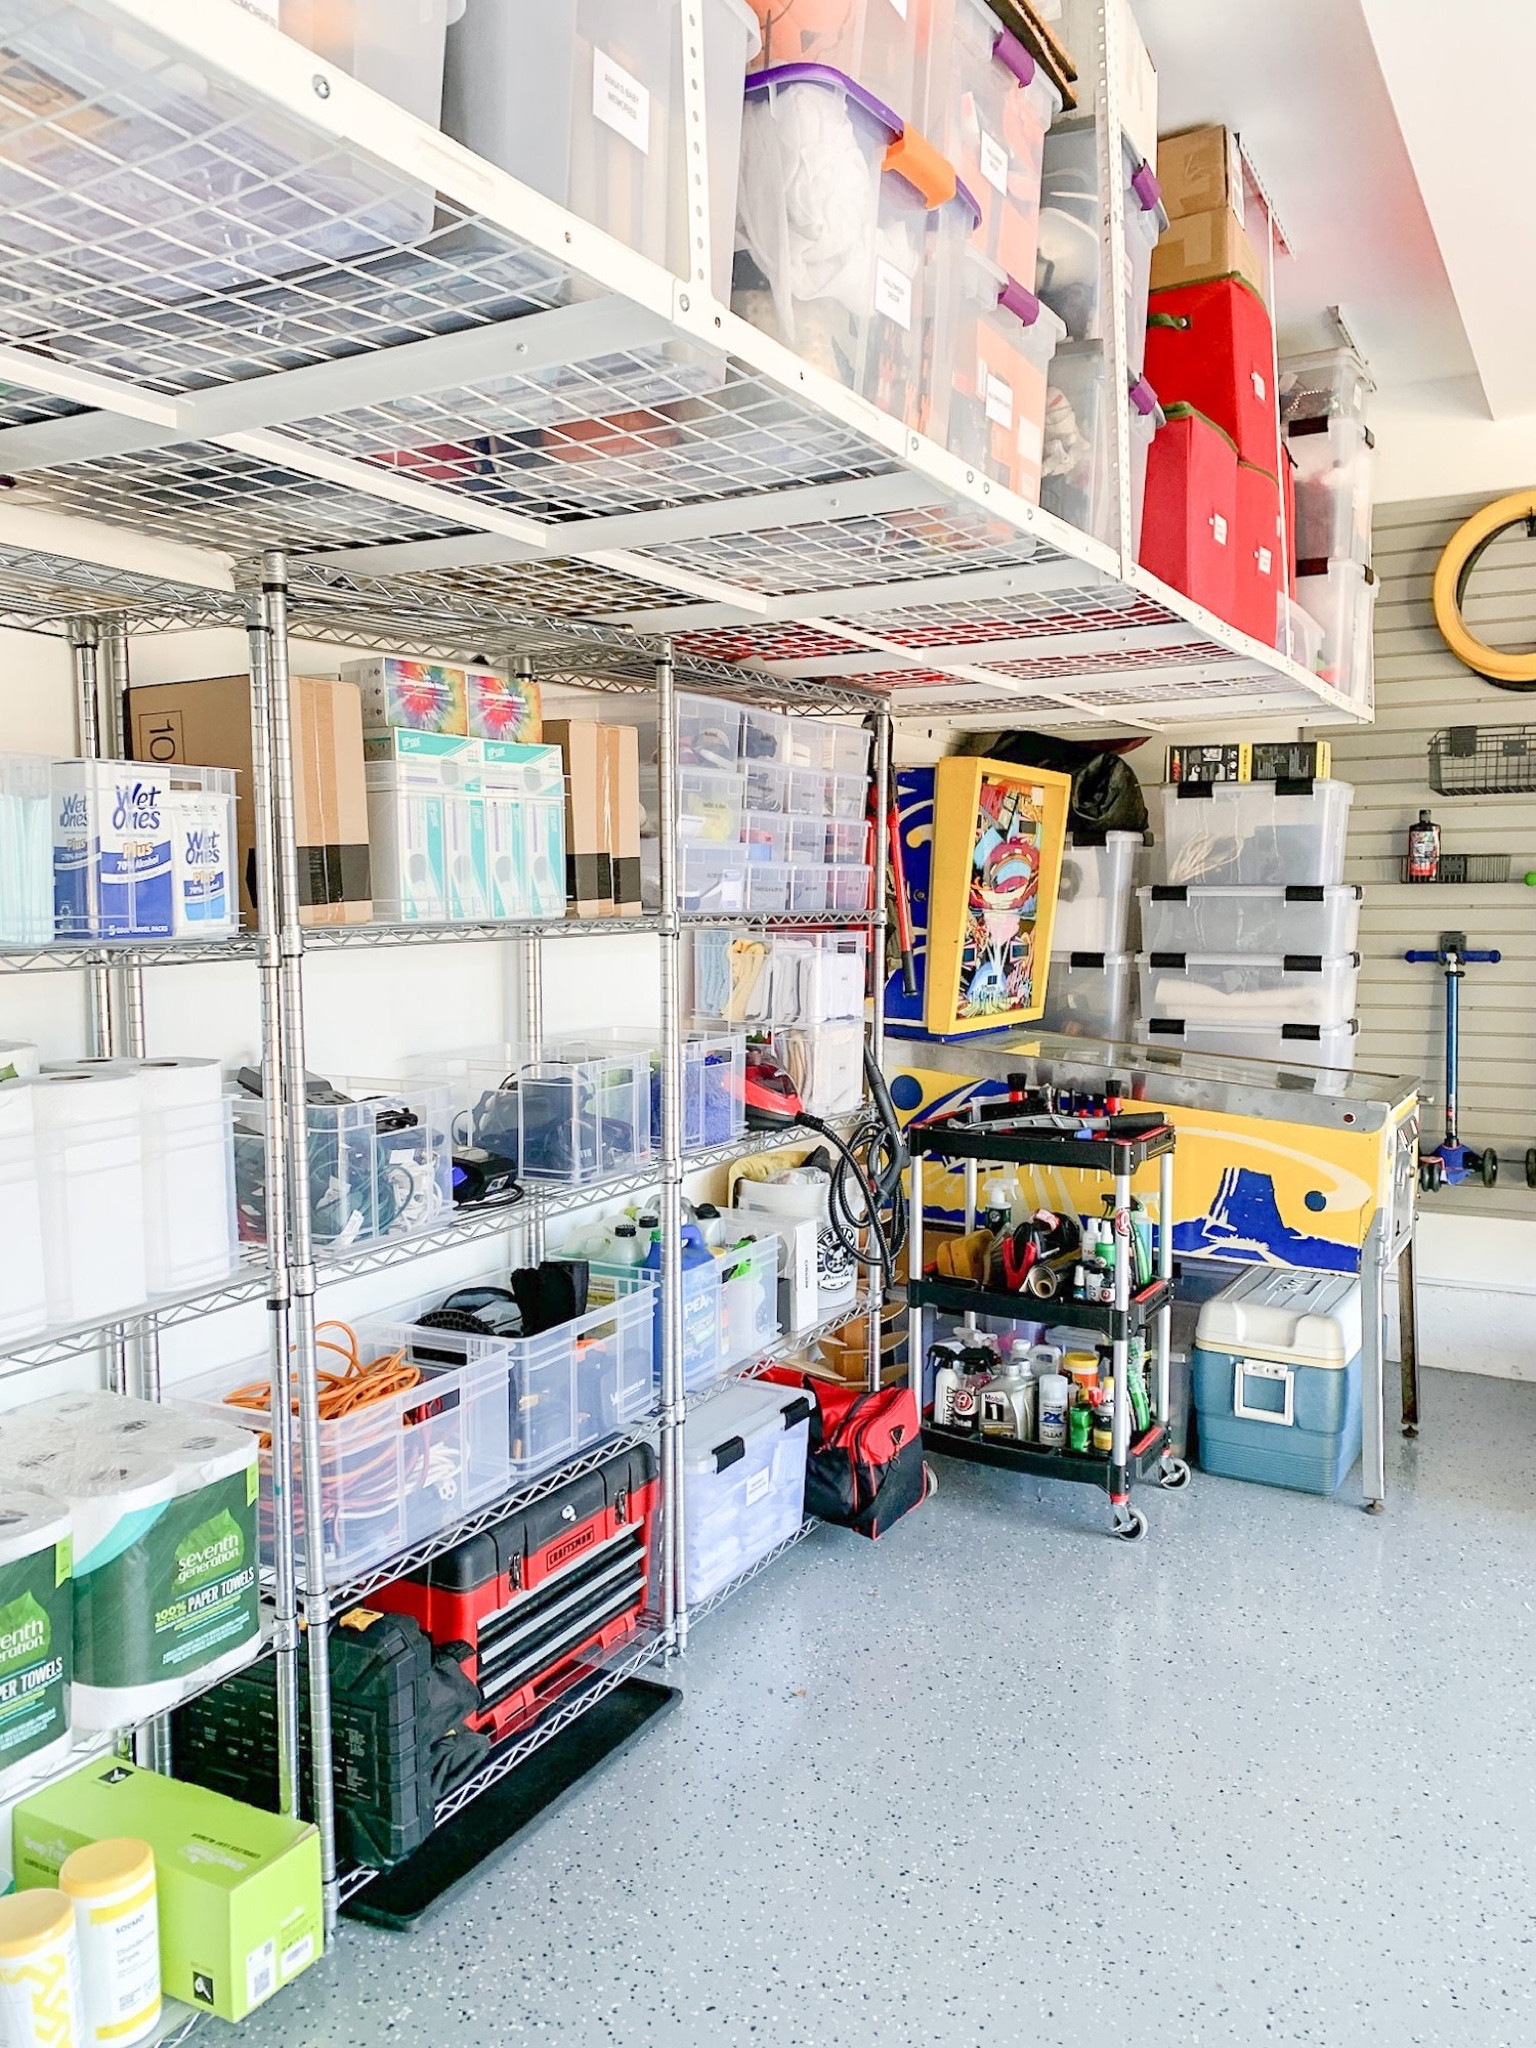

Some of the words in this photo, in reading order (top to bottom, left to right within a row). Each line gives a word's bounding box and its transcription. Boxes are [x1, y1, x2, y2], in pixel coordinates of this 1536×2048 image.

[115, 782, 162, 811] Wet
[123, 841, 154, 859] Plus
[192, 870, 215, 885] Pls
[984, 1393, 1005, 1403] Mobil
[990, 1403, 998, 1420] 1
[178, 1532, 239, 1572] seventh
[549, 1531, 592, 1565] CRAFTSMAN
[177, 1548, 240, 1584] generation
[187, 1584, 219, 1613] PAPER
[221, 1566, 255, 1598] TOWELS
[155, 1601, 187, 1622] 100%
[0, 1620, 43, 1651] enth
[20, 1656, 63, 1692] TOWELS
